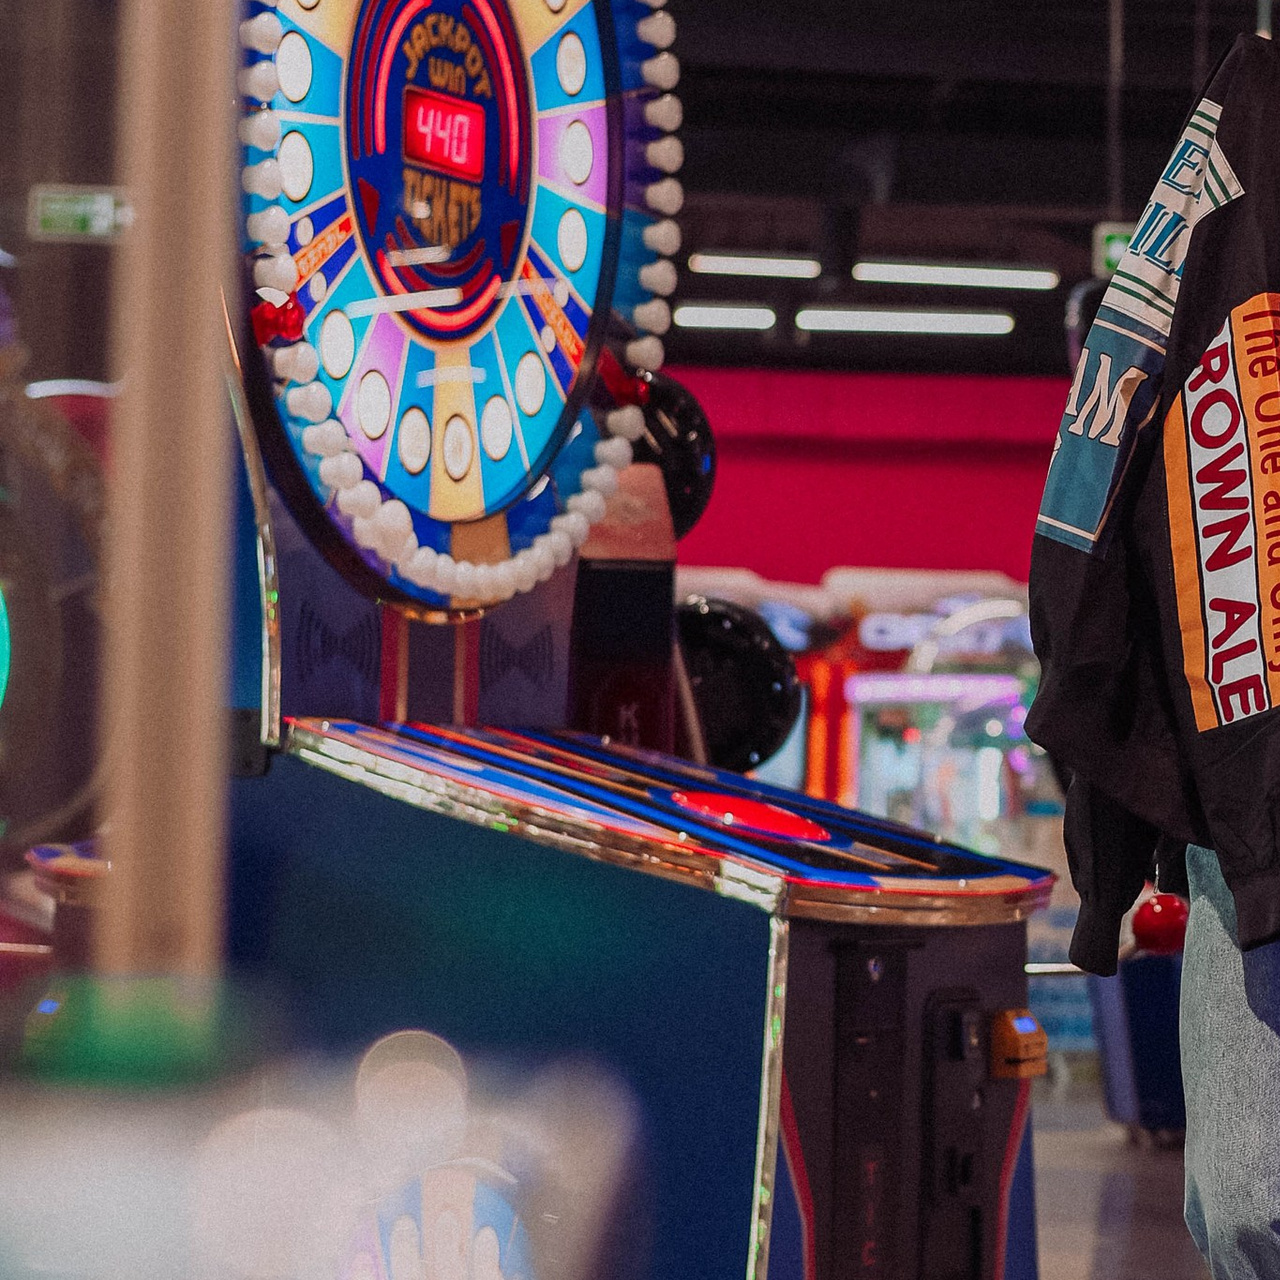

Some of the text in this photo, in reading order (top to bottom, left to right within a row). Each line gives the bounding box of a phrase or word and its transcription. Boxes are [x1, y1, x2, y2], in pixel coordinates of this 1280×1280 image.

[402, 12, 492, 99] JACKPOT
[428, 55, 466, 96] WIN
[416, 105, 471, 165] 440
[1187, 324, 1267, 723] ROWN ALE
